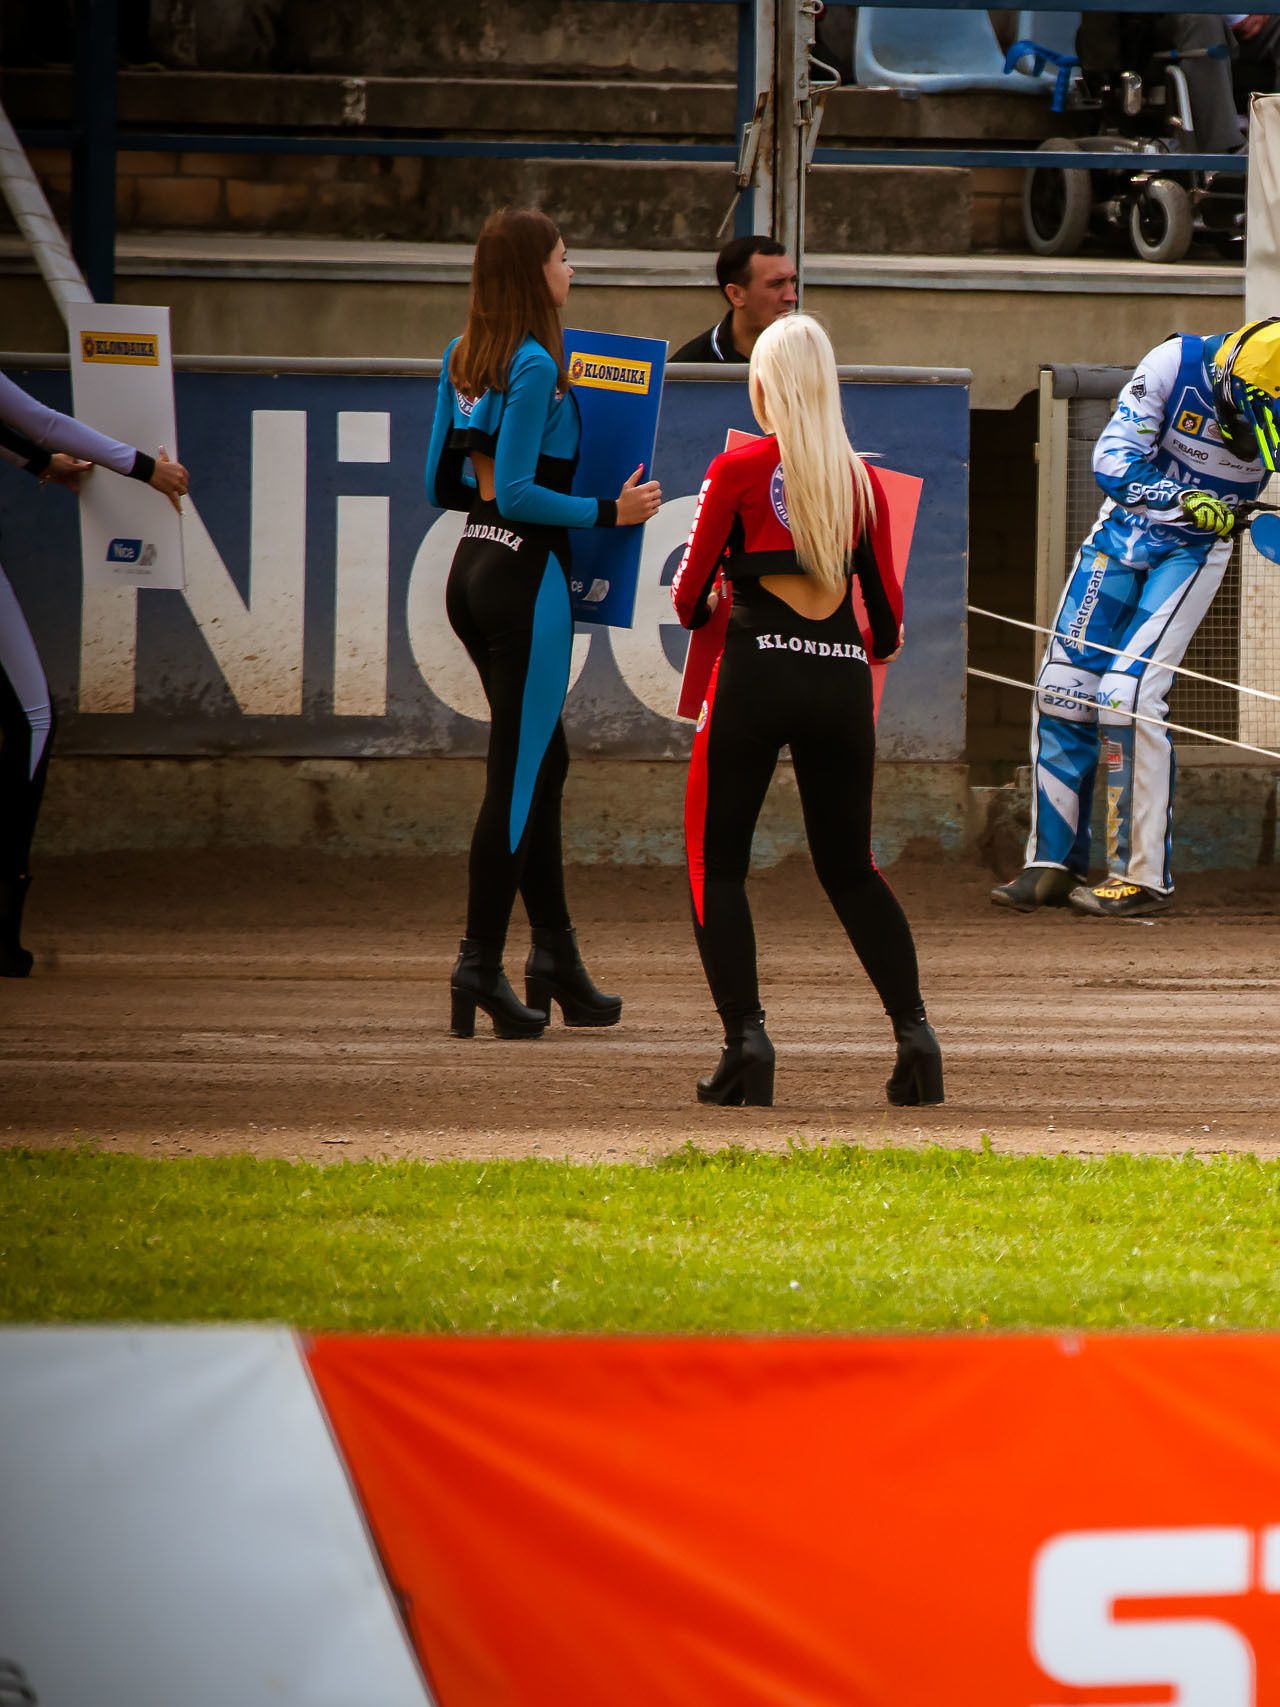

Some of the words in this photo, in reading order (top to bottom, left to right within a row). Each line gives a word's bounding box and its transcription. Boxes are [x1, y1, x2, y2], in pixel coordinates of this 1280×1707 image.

[584, 362, 646, 385] KLONDAIKA
[1172, 438, 1209, 462] FIBARO
[463, 524, 524, 551] LONDAIKA
[570, 575, 584, 592] ice
[755, 633, 869, 665] KLONDAIKA
